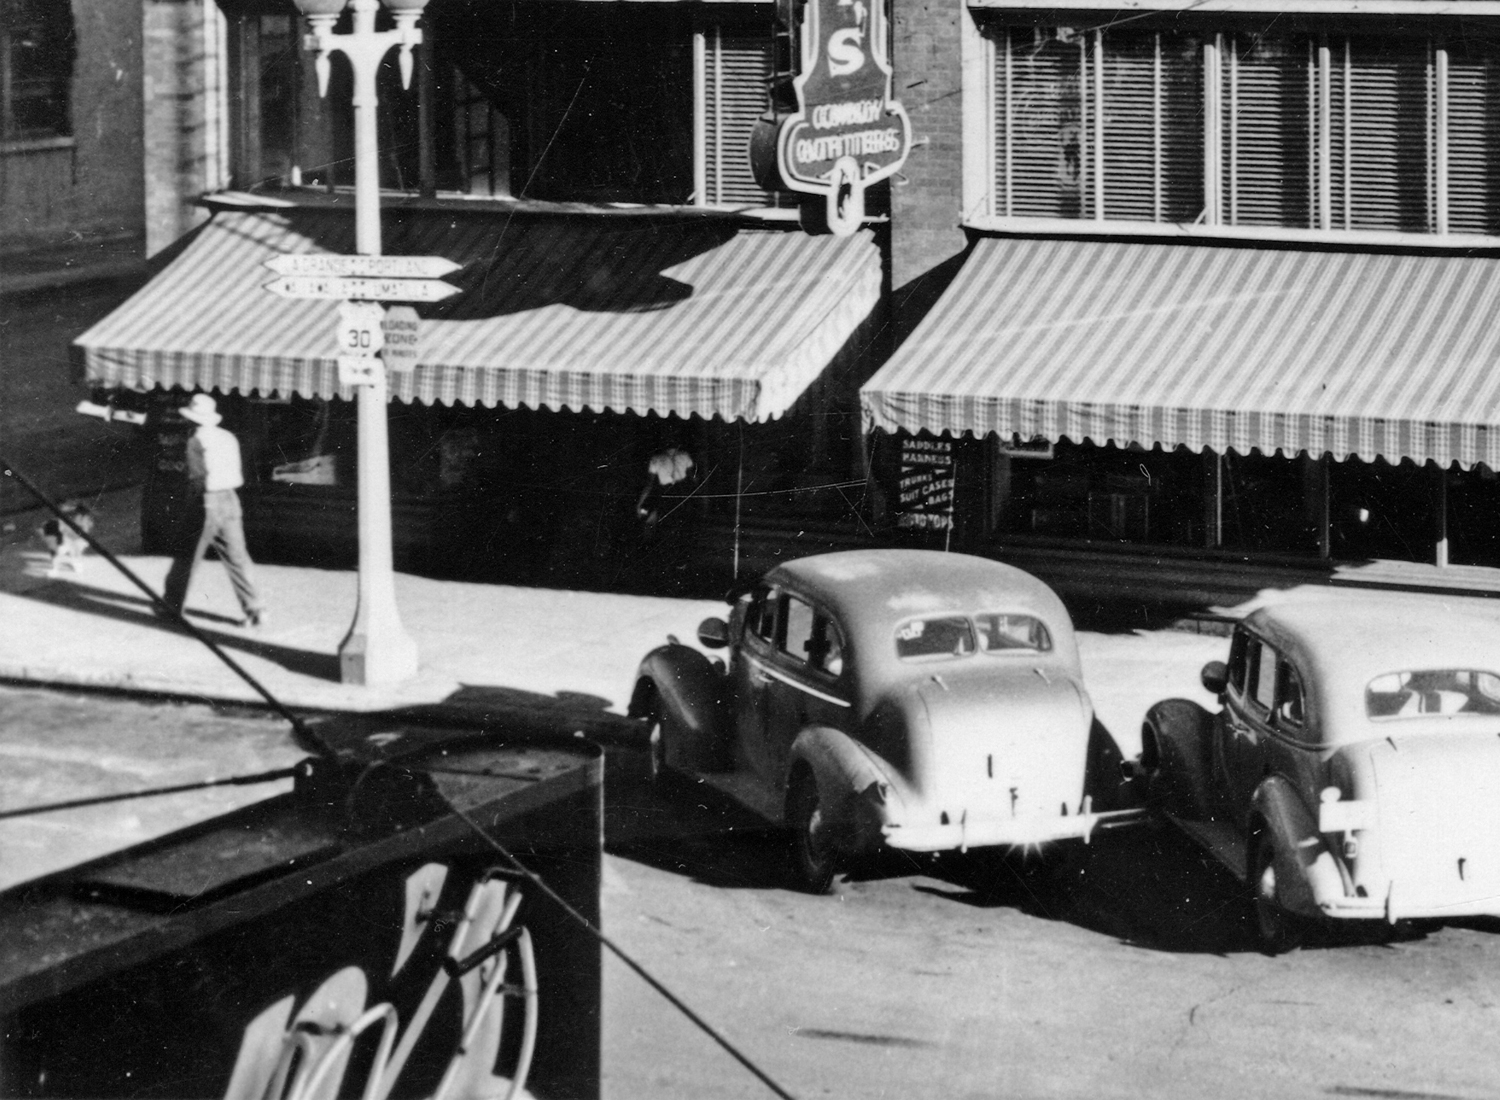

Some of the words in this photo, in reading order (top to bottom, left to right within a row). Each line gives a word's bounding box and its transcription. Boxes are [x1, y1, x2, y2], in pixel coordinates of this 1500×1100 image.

[348, 328, 371, 349] 30
[902, 439, 951, 452] SADDLES
[902, 452, 951, 465] HARNESS
[899, 473, 933, 490] TRUNKS
[899, 488, 920, 503] SUIT
[922, 478, 954, 496] CASES
[928, 489, 954, 505] BAGS
